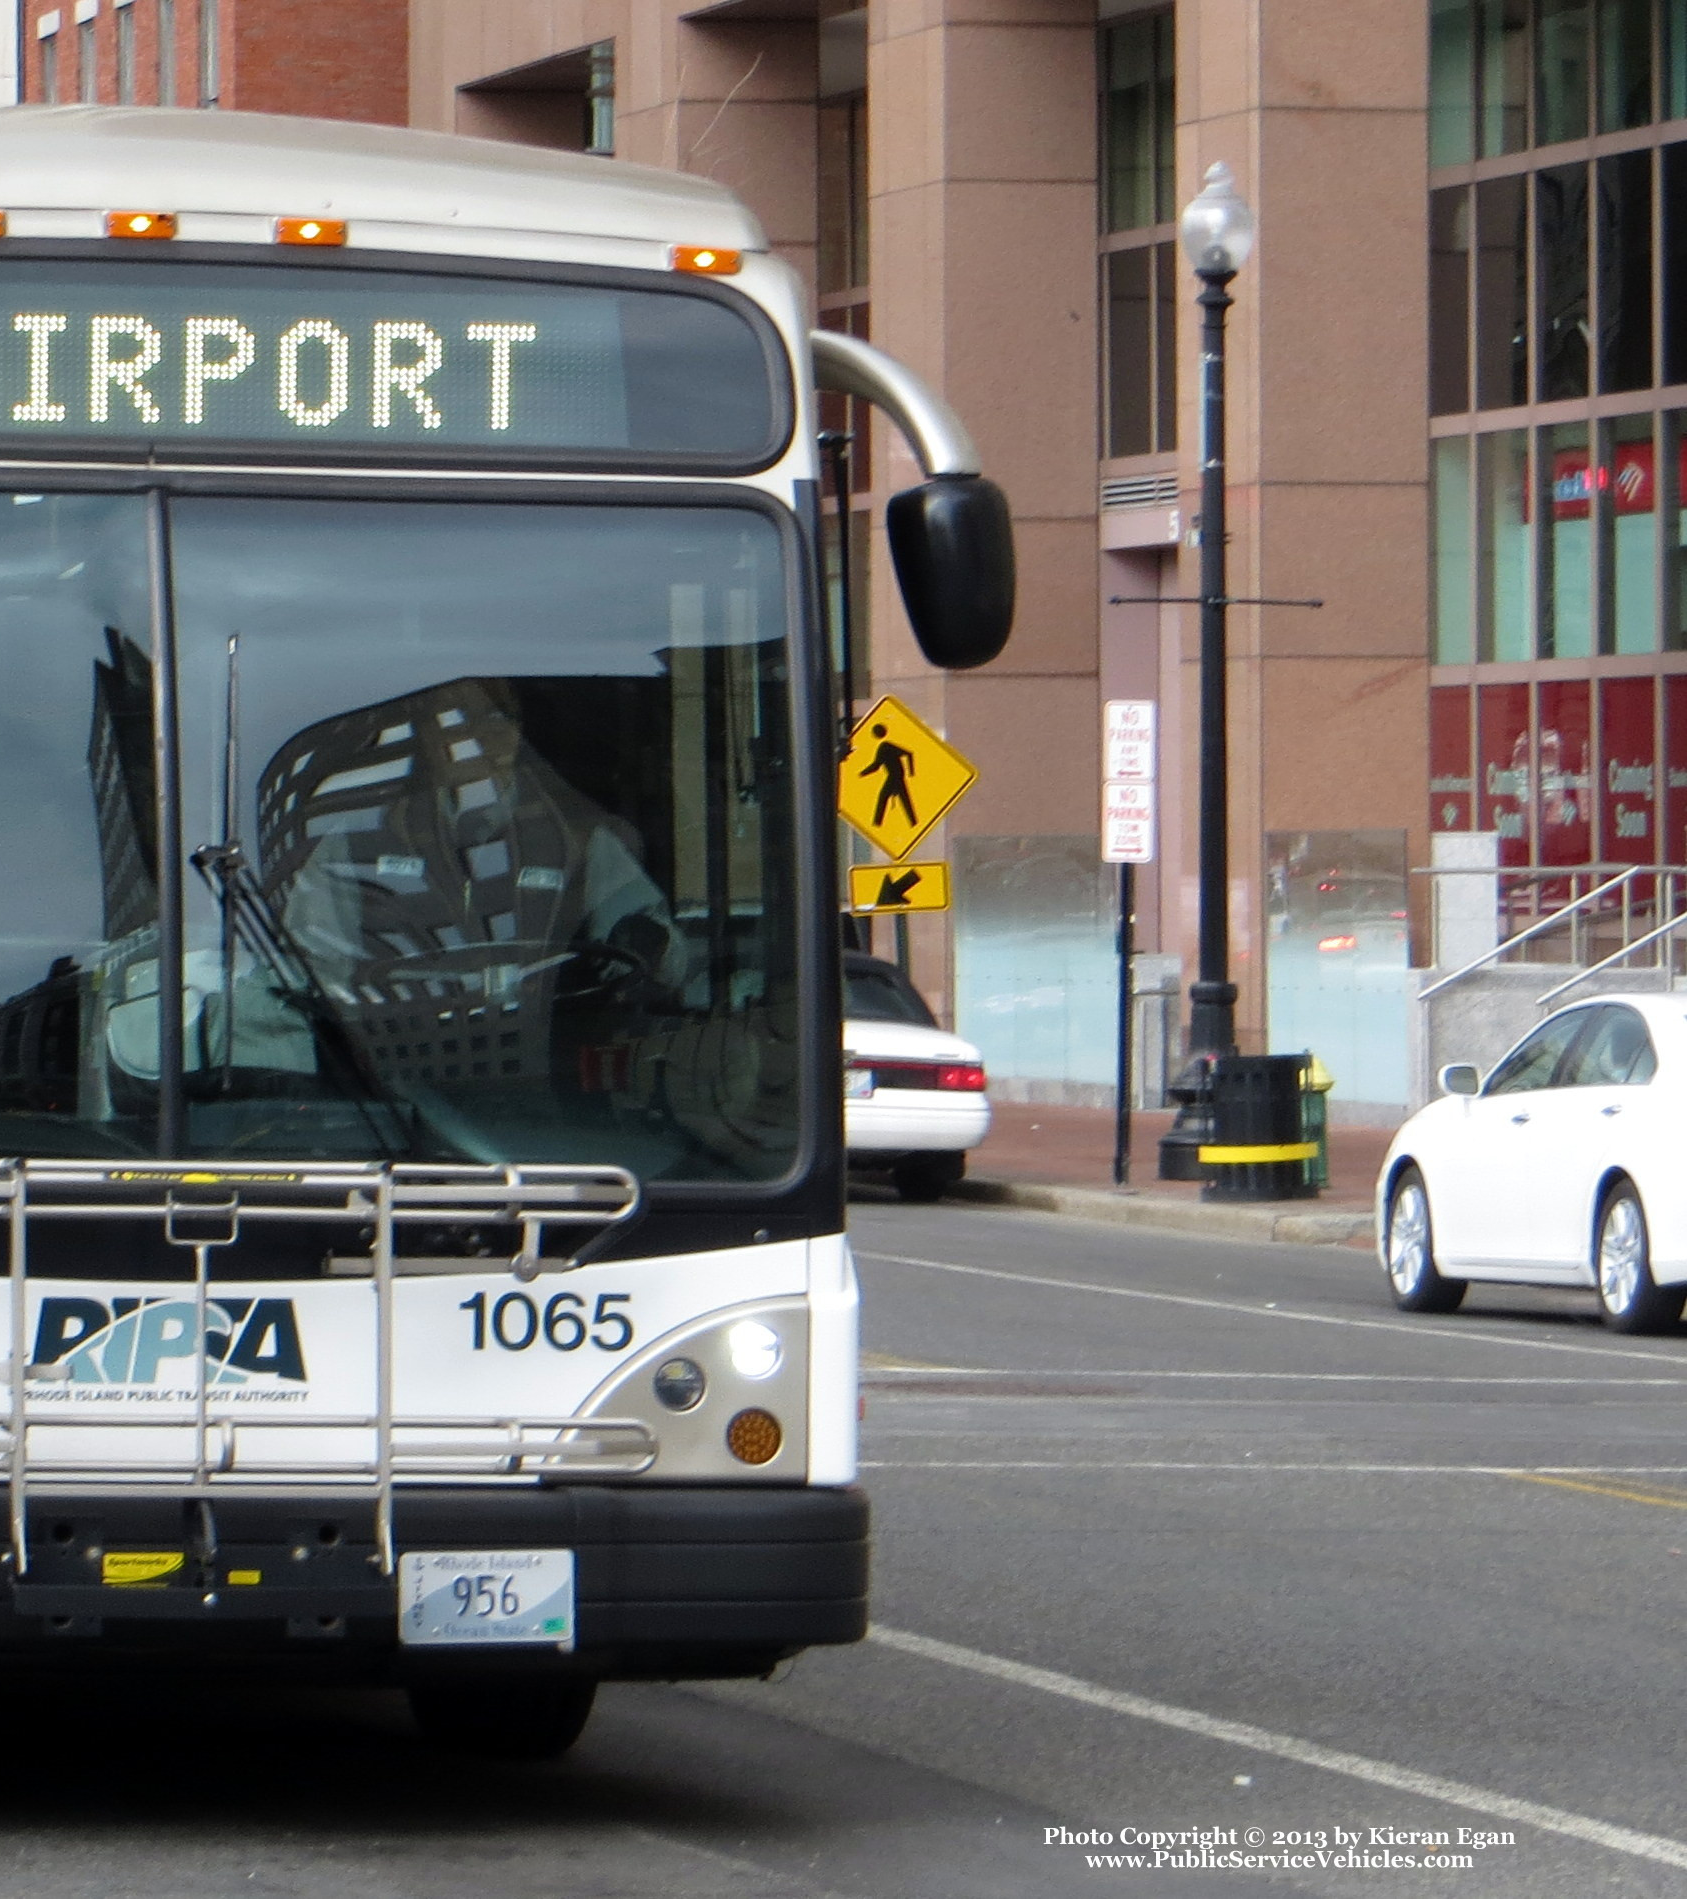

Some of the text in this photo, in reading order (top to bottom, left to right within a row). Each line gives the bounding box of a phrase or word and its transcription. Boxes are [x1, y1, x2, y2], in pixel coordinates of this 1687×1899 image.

[21, 1296, 309, 1385] RIPTA
[459, 1290, 634, 1352] 1065
[452, 1572, 520, 1618] 956
